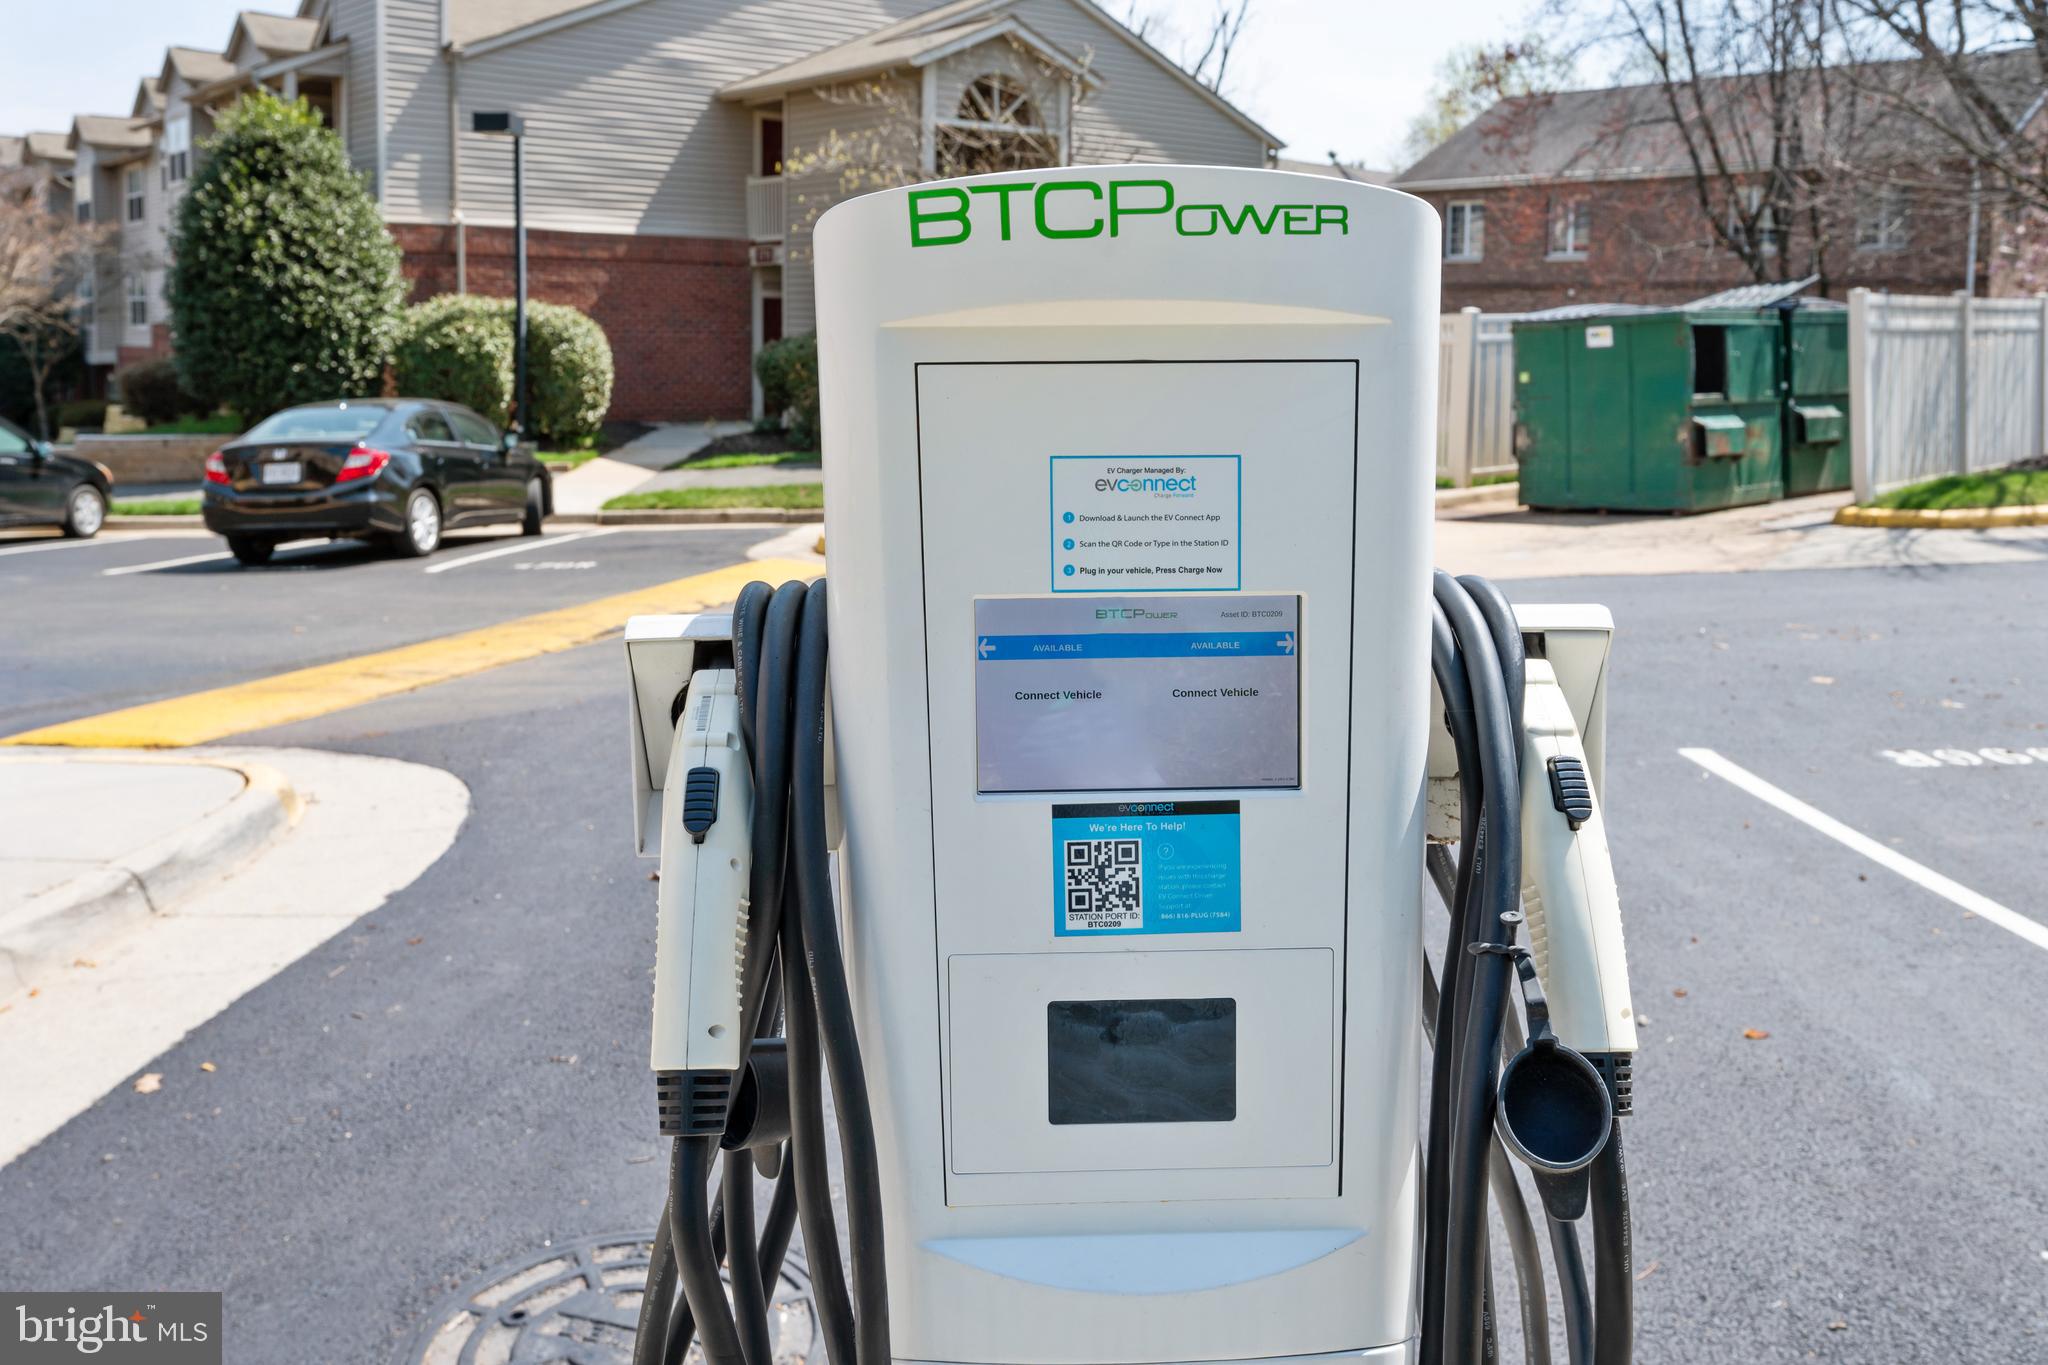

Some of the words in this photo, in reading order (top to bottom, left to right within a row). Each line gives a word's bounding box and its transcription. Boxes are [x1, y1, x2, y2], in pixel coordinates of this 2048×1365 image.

[1116, 467, 1142, 475] Charger
[1144, 467, 1174, 475] Managed
[1176, 467, 1186, 475] By:
[1094, 476, 1197, 492] evconnect
[1205, 514, 1221, 522] App
[1111, 540, 1123, 548] QR
[1153, 540, 1171, 548] Type
[1079, 567, 1097, 576] Plug
[1155, 566, 1177, 574] Press
[1178, 566, 1205, 575] Charge
[1251, 610, 1283, 618] BTC0209
[1032, 644, 1083, 653] AVAILABLE
[1190, 641, 1241, 650] AVAILABLE
[1014, 691, 1060, 701] Connect
[1062, 690, 1102, 700] Vehicle
[1172, 688, 1218, 698] Connect
[1220, 687, 1259, 698] Vehicle
[1089, 823, 1117, 832] We're
[1119, 823, 1143, 831] Here
[1146, 822, 1158, 831] To
[1160, 821, 1186, 831] Help!
[1105, 912, 1127, 920] PORT
[1087, 920, 1122, 928] BTC0209
